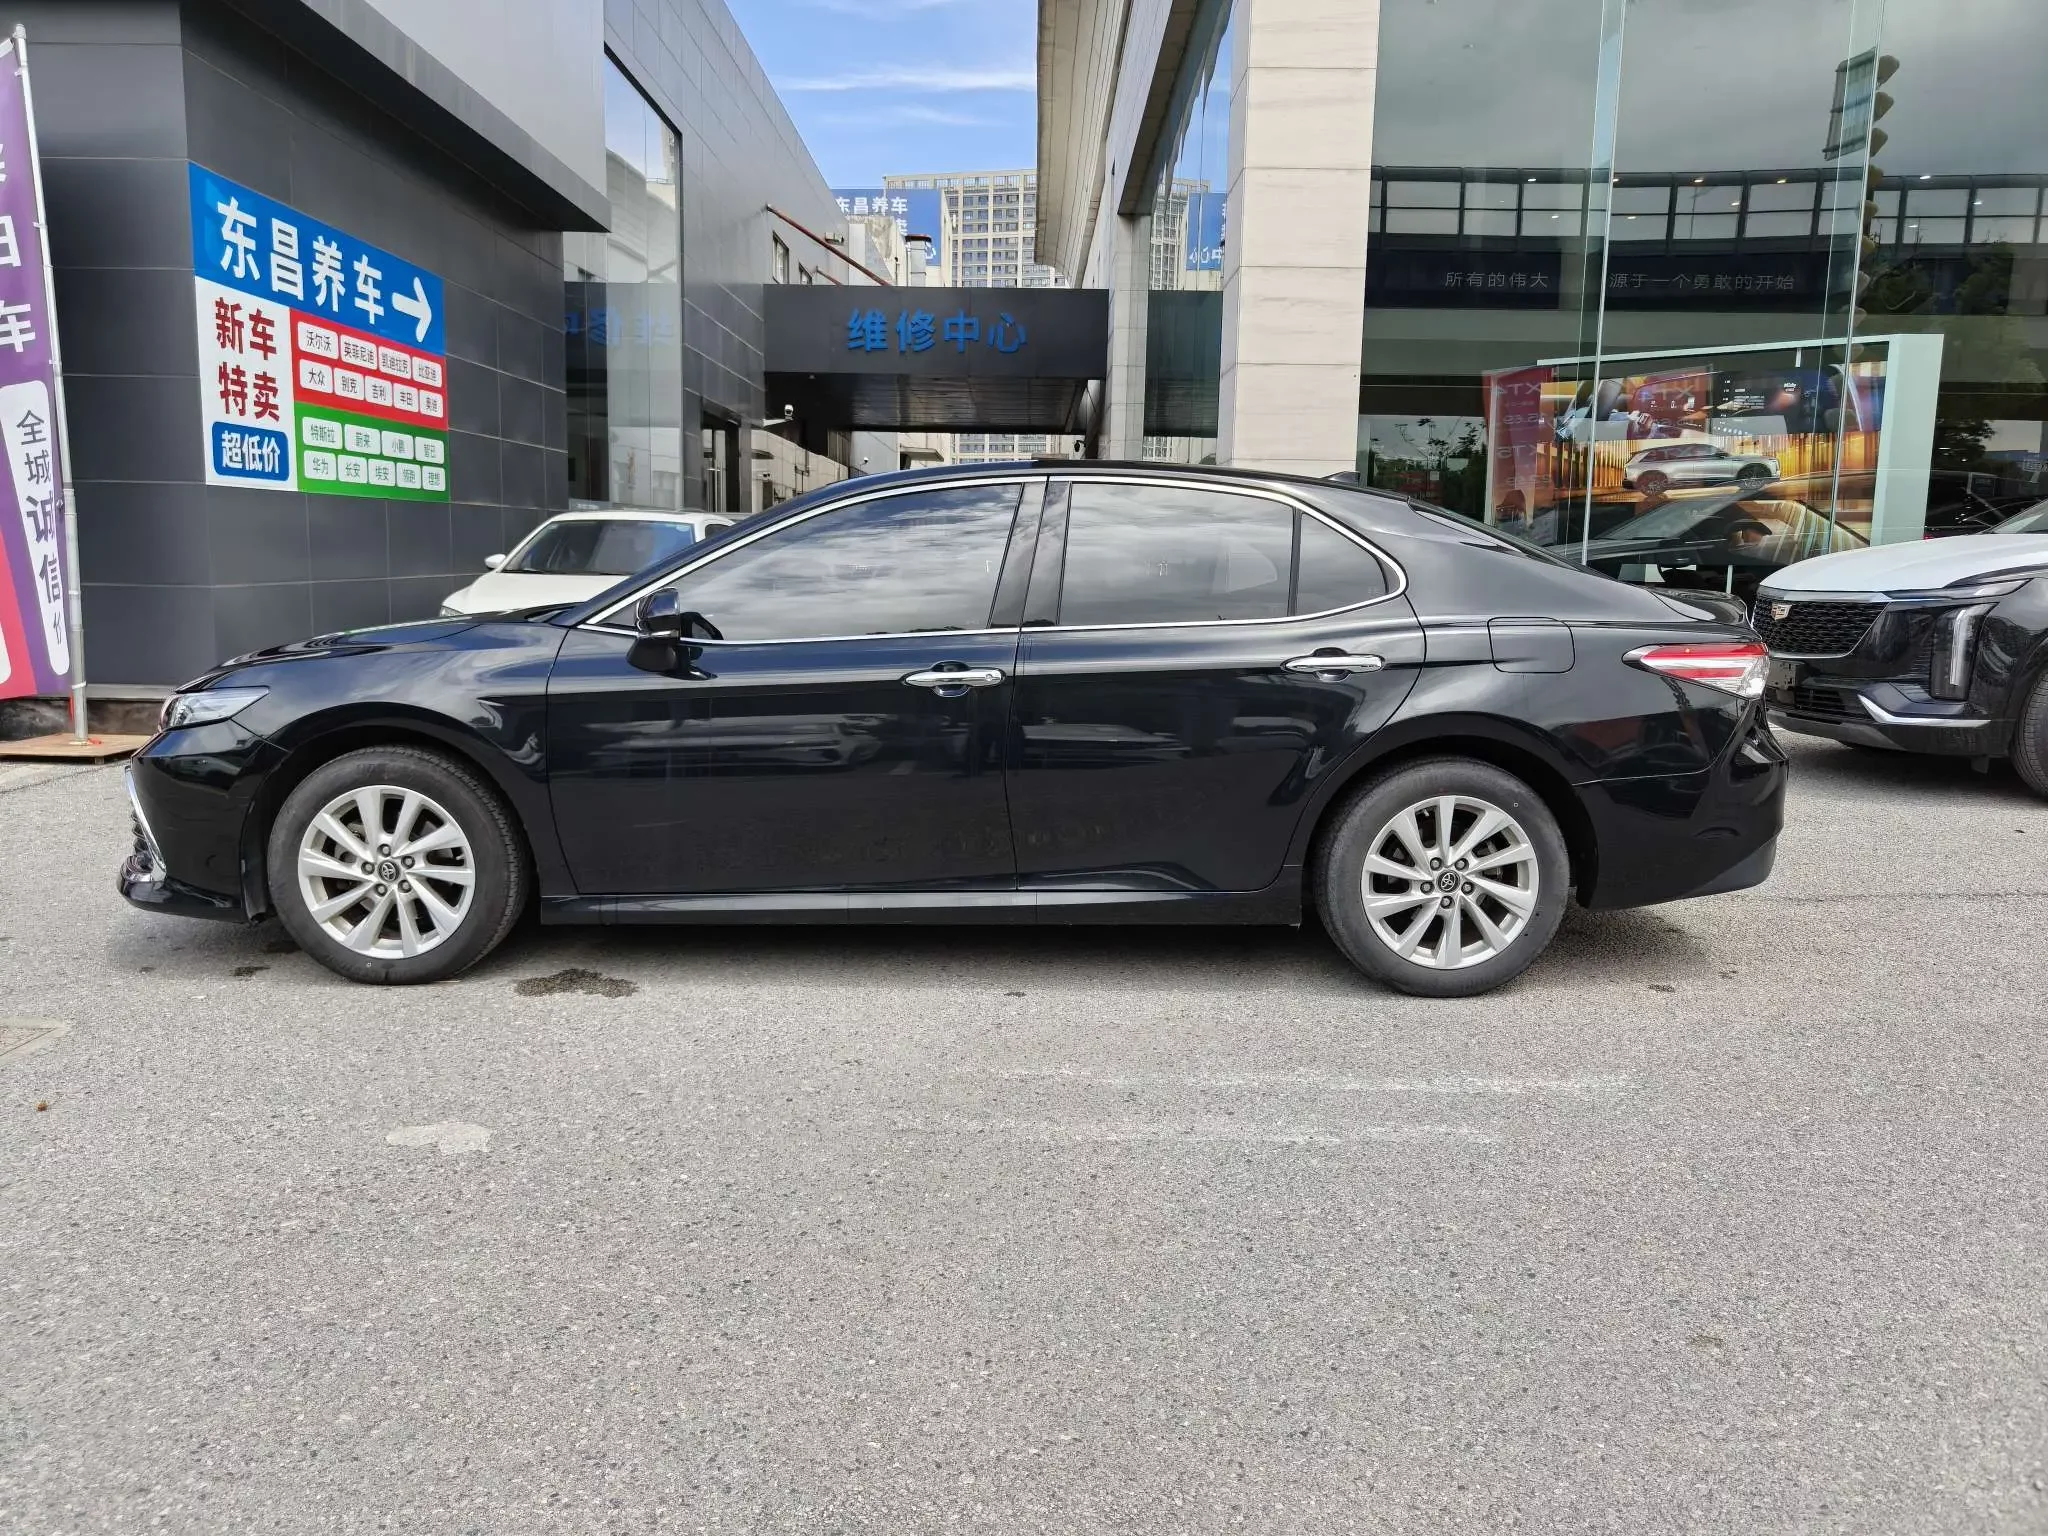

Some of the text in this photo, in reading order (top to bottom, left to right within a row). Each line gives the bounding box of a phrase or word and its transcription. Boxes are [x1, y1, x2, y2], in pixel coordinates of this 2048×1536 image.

[834, 196, 908, 216] 东昌养车
[217, 196, 385, 324] 东昌养车
[1445, 271, 1795, 290] 所有的伟大 源于一个勇敢的开始
[215, 296, 277, 361] 新车
[847, 308, 1027, 353] 维修中心
[306, 329, 332, 352] 沃尔沃
[308, 367, 326, 387] 大众
[341, 375, 358, 394] 别克
[218, 361, 281, 422] 特卖
[372, 383, 387, 401] 吉利
[310, 424, 336, 444] 特斯拉
[222, 430, 280, 474] 超低价
[312, 457, 329, 475] 华为
[345, 462, 361, 478] 长安
